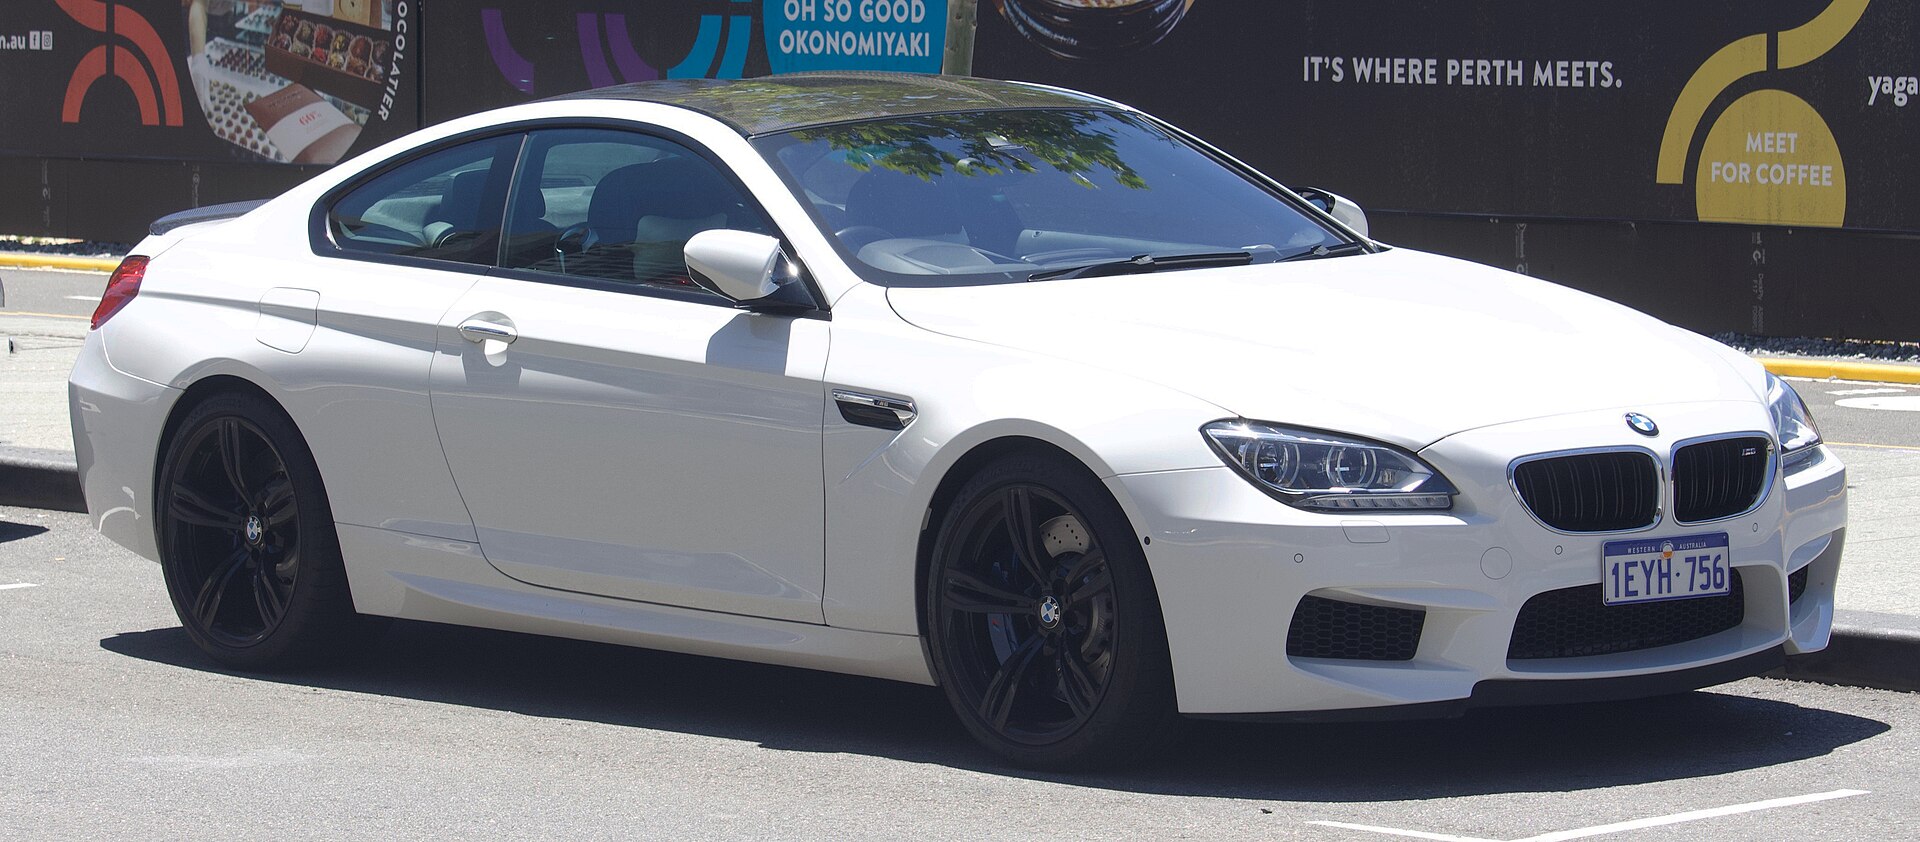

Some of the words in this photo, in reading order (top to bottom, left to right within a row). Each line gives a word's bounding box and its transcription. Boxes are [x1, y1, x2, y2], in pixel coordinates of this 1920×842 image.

[783, 0, 816, 21] OH
[823, 0, 852, 22] SO
[859, 0, 926, 23] GOOD
[779, 29, 930, 57] OKONOMIYAKI
[378, 1, 408, 121] OCOLATIER
[1303, 56, 1344, 83] IT'S
[1352, 57, 1437, 84] WHERE
[1447, 59, 1523, 86] PERTH
[1532, 60, 1622, 88] MEETS.
[1746, 132, 1798, 154] MEET
[1711, 162, 1750, 184] FOR
[1756, 163, 1833, 186] COFFEE
[1627, 546, 1656, 554] WESTERN
[1679, 541, 1707, 550] AUSTRALIA
